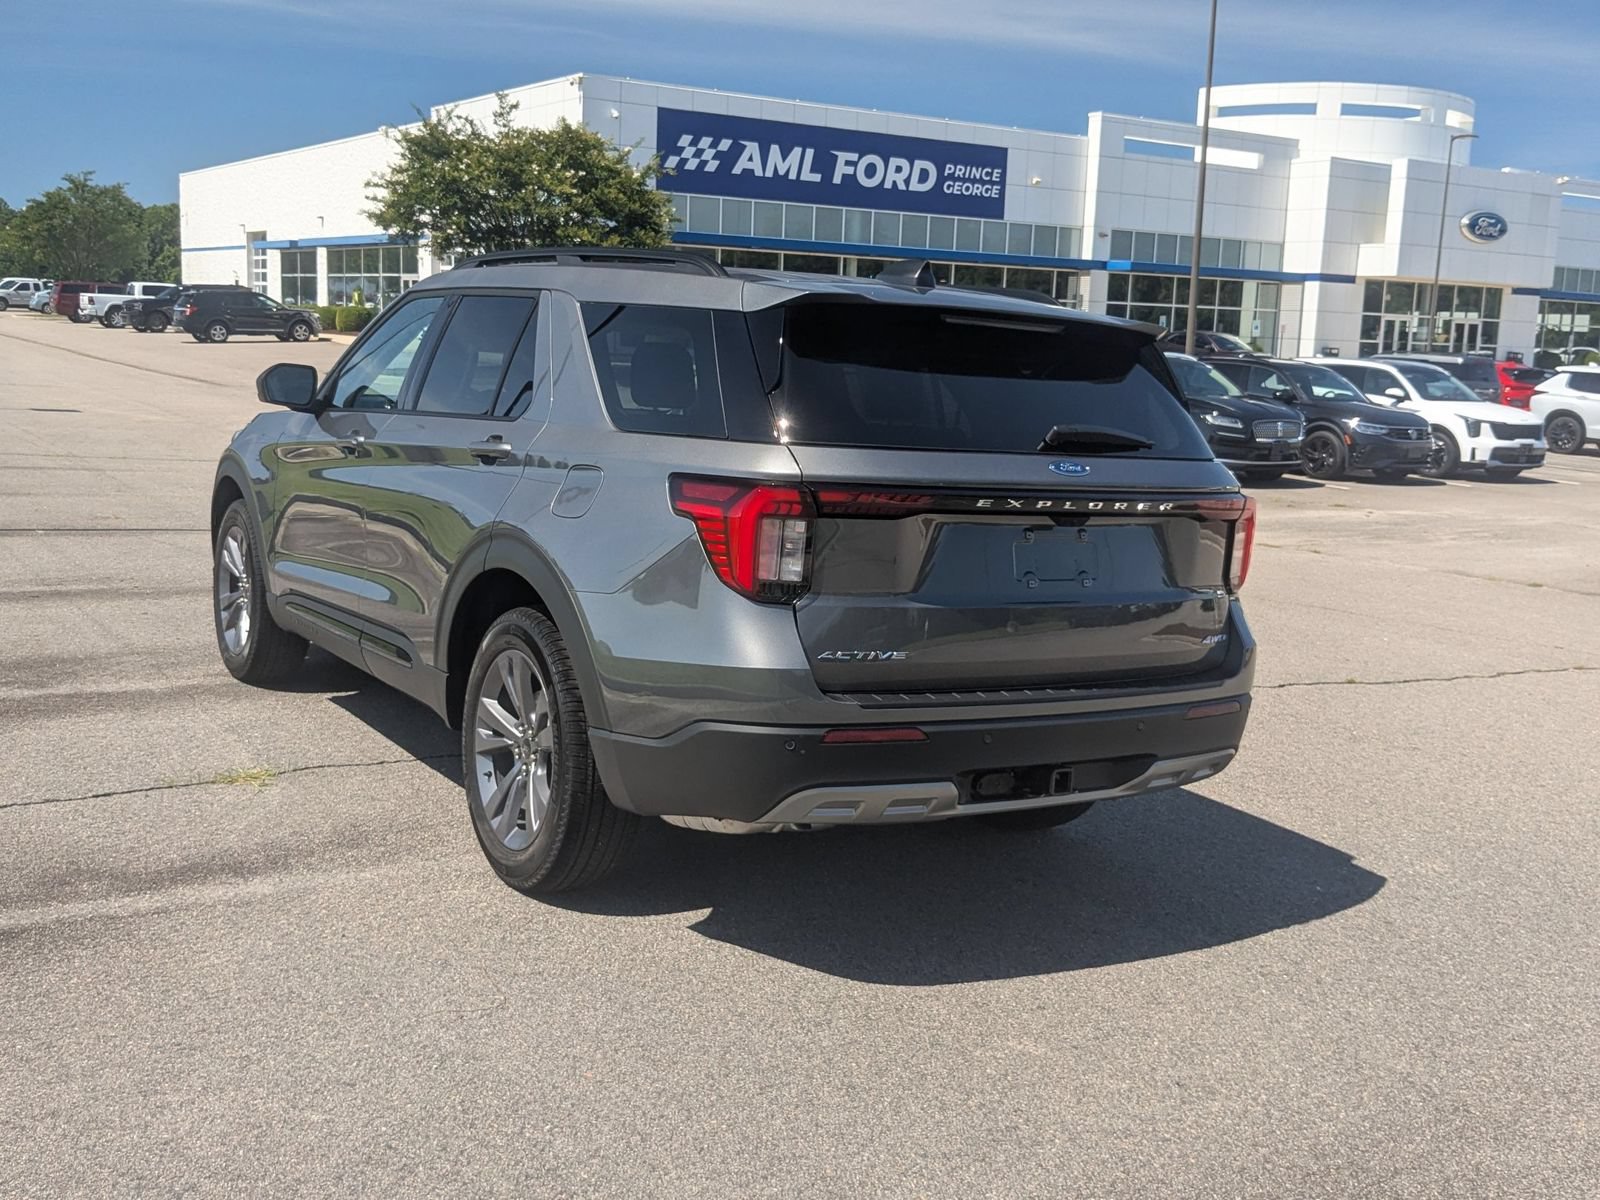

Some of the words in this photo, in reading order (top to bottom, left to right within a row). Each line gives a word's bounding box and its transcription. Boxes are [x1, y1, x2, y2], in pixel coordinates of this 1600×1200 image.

[731, 140, 822, 182] AML
[830, 150, 937, 192] FORD
[943, 164, 1002, 182] PRINCE
[943, 180, 1001, 198] GEORGE
[1474, 217, 1502, 236] Ford
[976, 498, 1174, 511] EXPLORER
[817, 650, 909, 661] ACTIVE
